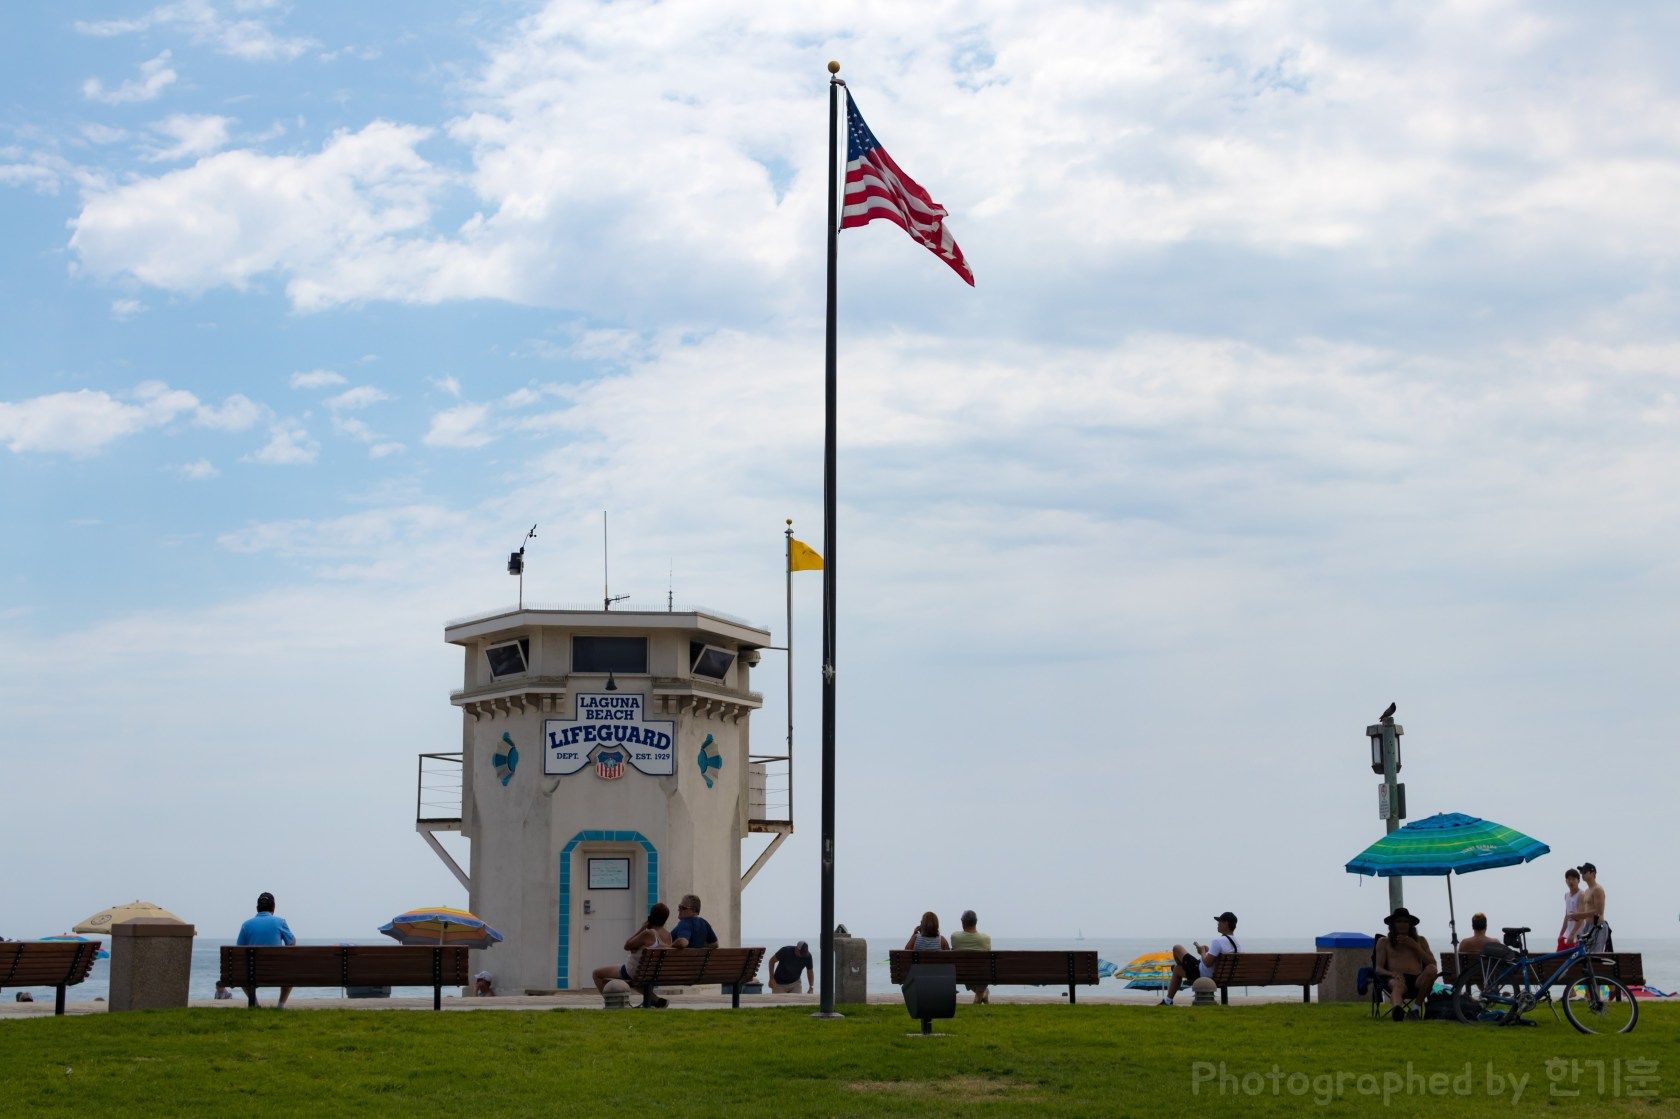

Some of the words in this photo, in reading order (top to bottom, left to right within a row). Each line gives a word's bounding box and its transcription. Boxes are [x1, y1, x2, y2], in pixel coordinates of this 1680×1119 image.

[580, 697, 640, 708] LAGUNA
[586, 709, 634, 720] BEACH
[548, 725, 671, 750] LIFEGUARD
[556, 752, 579, 760] DEPT.
